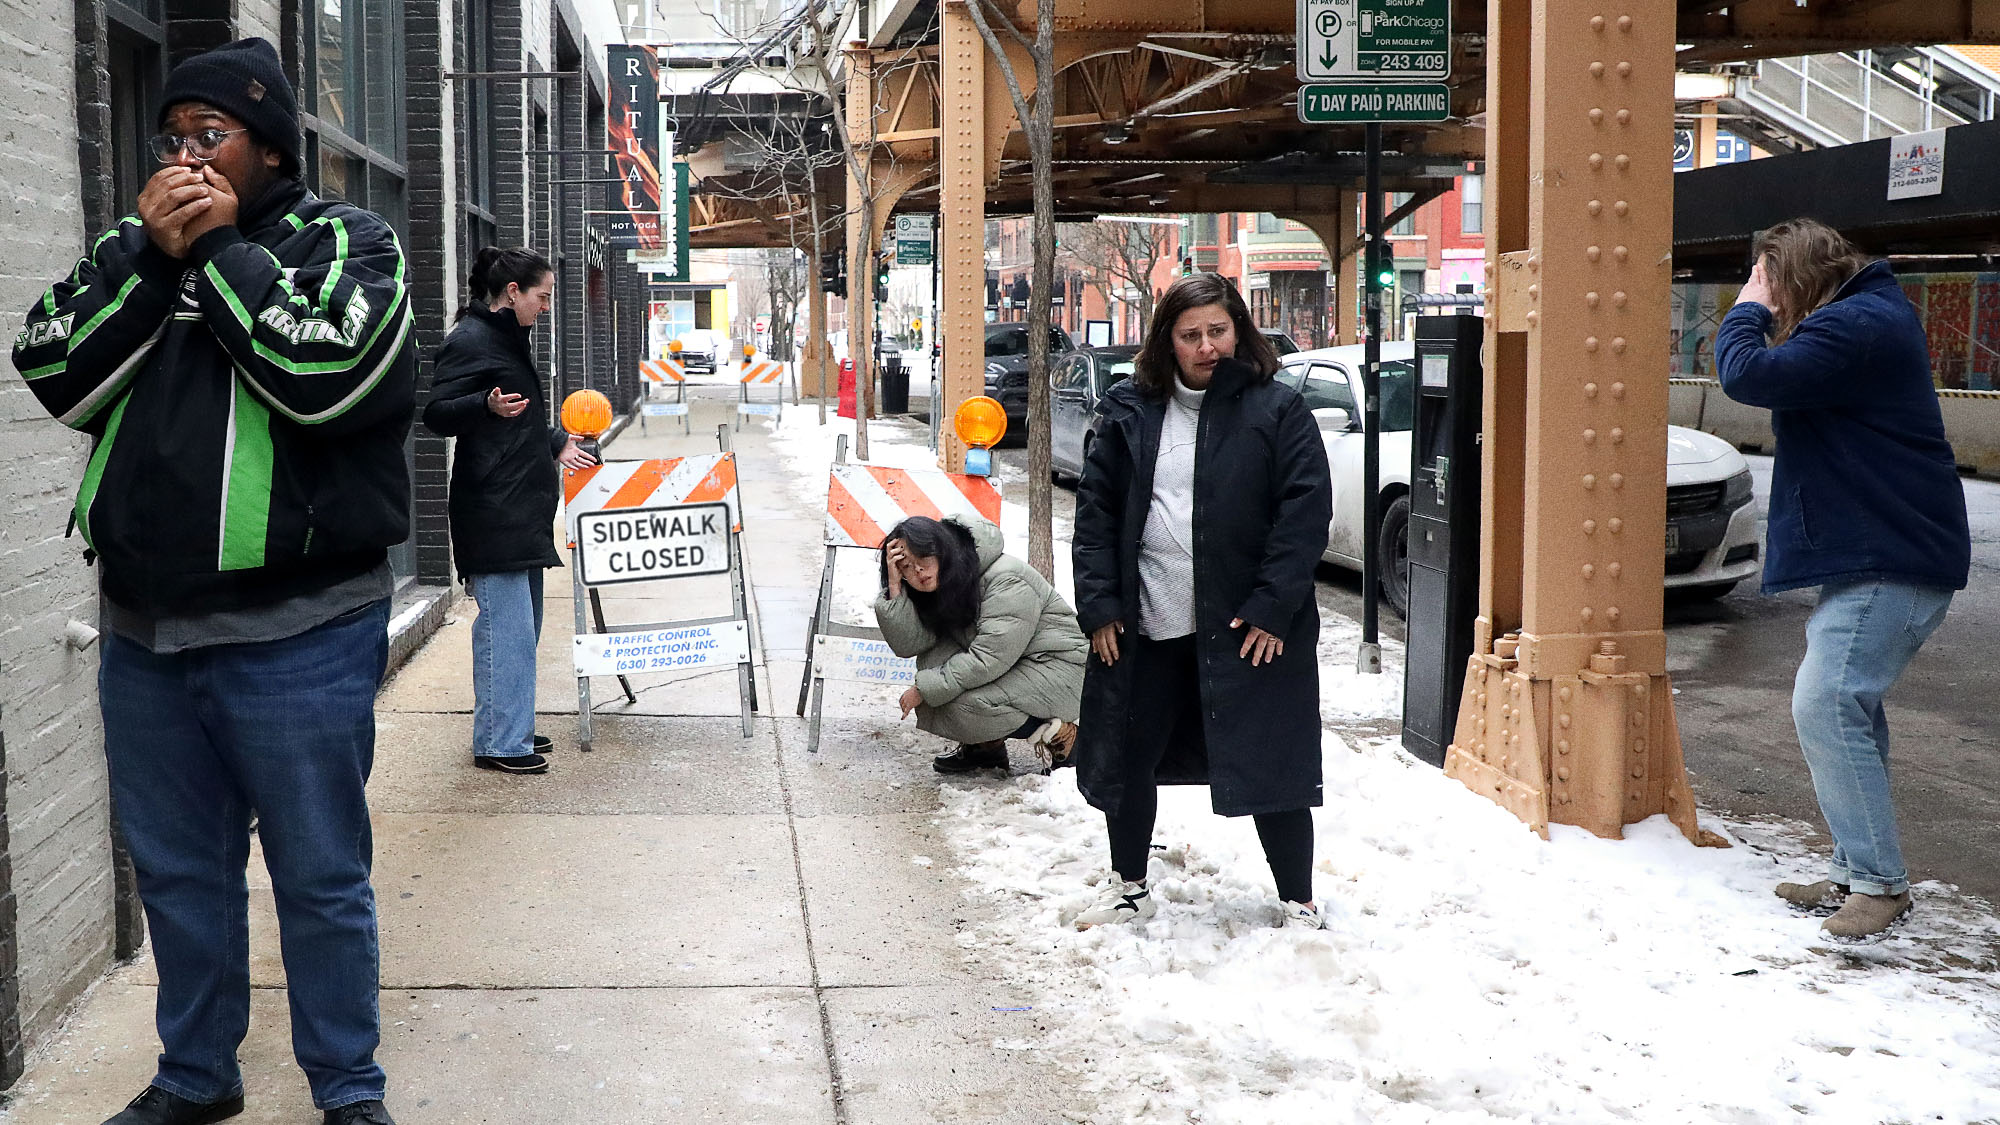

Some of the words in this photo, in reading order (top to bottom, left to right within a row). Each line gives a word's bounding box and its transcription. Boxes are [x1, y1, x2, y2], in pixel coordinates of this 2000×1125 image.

[1374, 15, 1444, 29] ParkChicago
[1381, 54, 1410, 69] 243
[1414, 54, 1445, 69] 409
[1308, 95, 1317, 112] 7
[1321, 94, 1347, 112] DAY
[1351, 94, 1382, 111] PAID
[1386, 93, 1445, 111] PARKING
[625, 57, 643, 209] RITUAL
[611, 222, 630, 230] HOT
[29, 312, 75, 347] CAT
[593, 513, 716, 544] SIDEWALK
[609, 545, 704, 573] CLOSED
[607, 634, 653, 646] TRAFFIC
[657, 627, 712, 642] CONTROL
[602, 648, 612, 658] &
[615, 641, 691, 658] PROTECTION
[694, 639, 719, 650] INC.
[616, 658, 647, 671] (630)
[650, 653, 706, 668] 293-0026
[857, 655, 914, 668] PROTECTI
[855, 667, 887, 680] (630)
